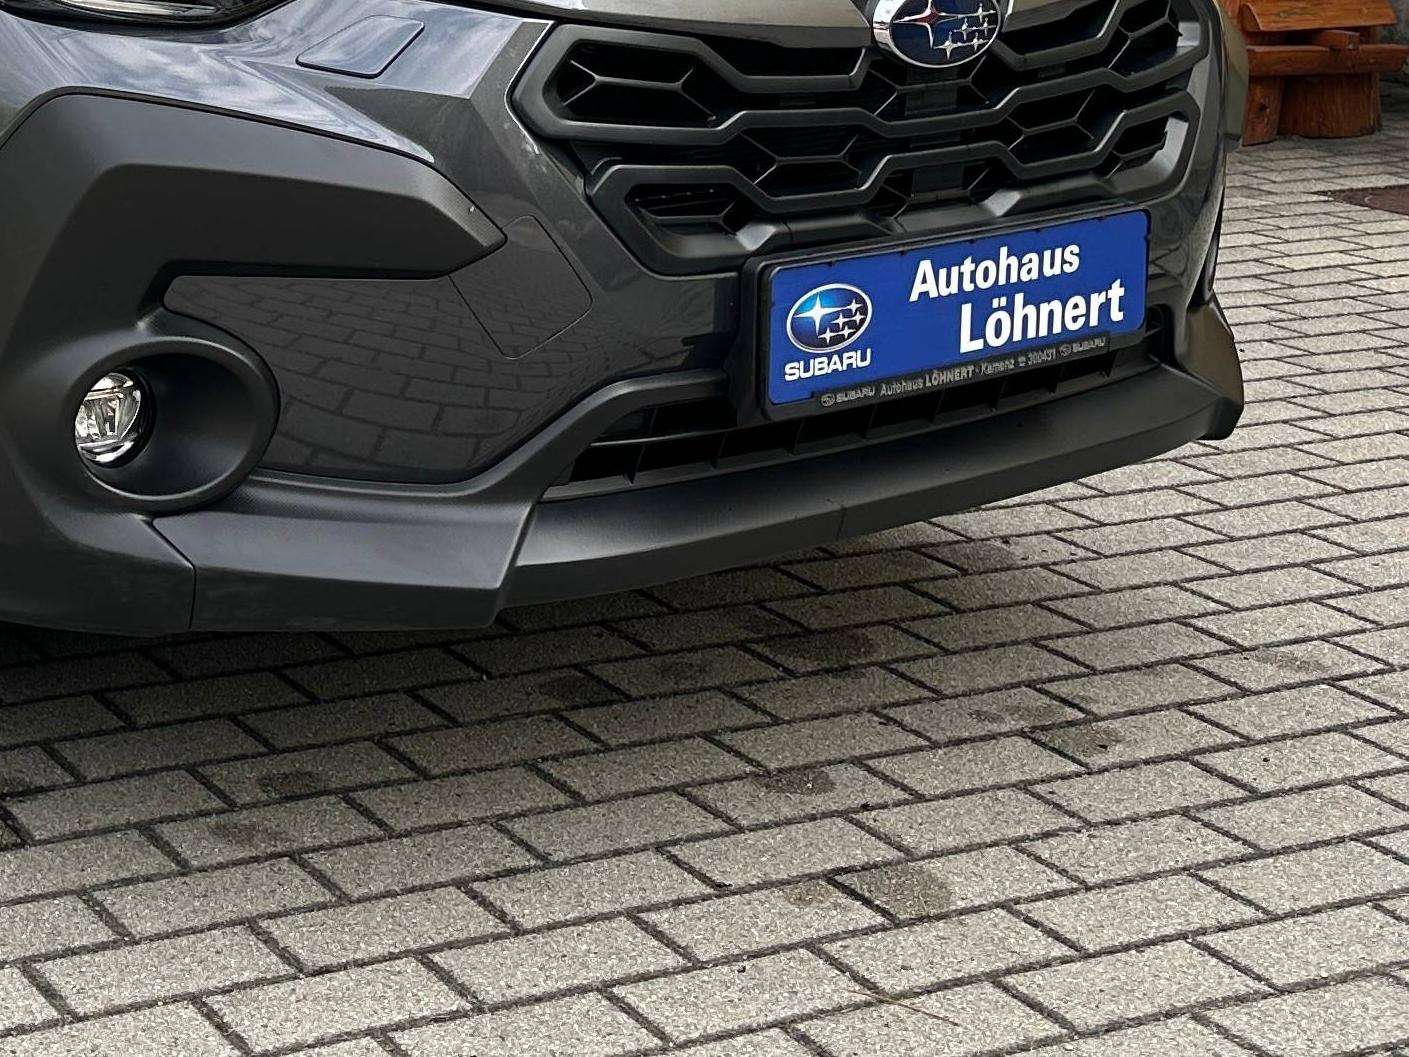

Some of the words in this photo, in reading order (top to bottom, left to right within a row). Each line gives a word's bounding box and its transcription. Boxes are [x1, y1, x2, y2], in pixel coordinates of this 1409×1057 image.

[908, 243, 1081, 303] Autohaus
[959, 277, 1125, 354] Löhnert
[784, 348, 872, 381] SUBARU
[835, 387, 876, 403] SUBARU
[880, 378, 924, 397] Autohaus
[925, 364, 975, 388] LÖHNERT
